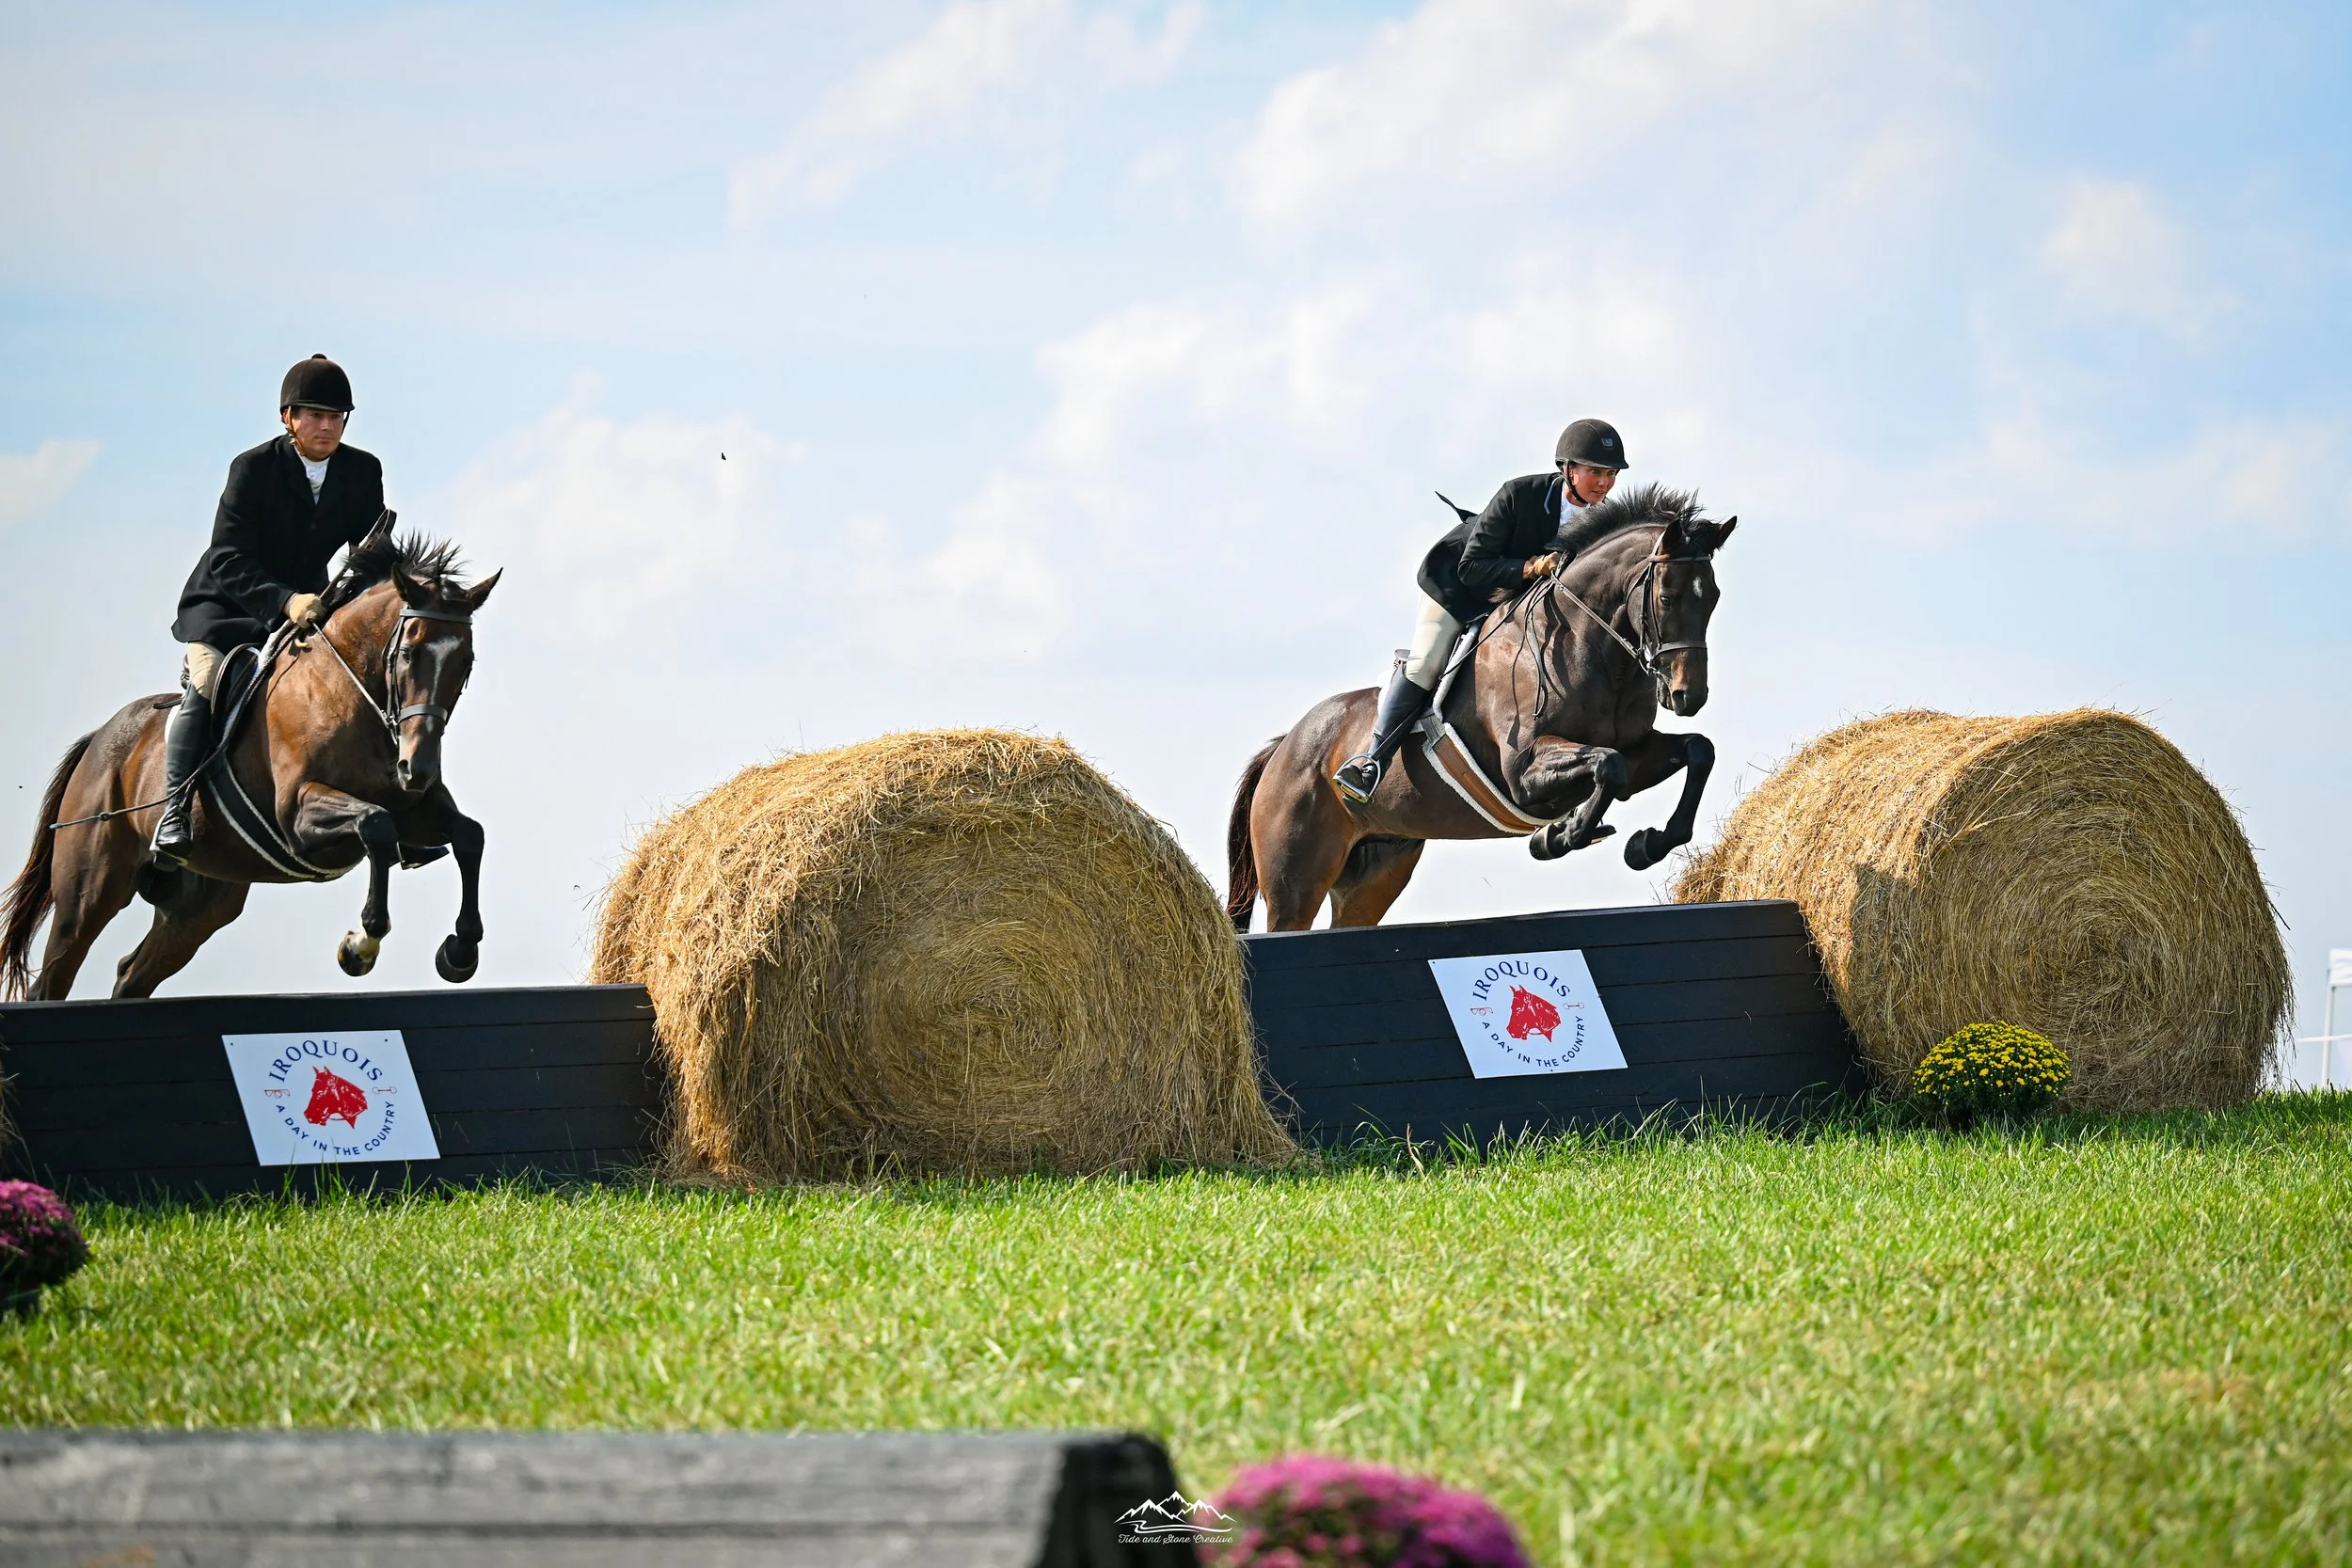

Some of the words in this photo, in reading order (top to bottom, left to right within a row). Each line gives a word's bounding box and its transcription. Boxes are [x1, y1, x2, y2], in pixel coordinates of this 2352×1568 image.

[1472, 959, 1570, 1001] IROQUOIS
[269, 1039, 383, 1083] IROQUOIS
[1490, 1033, 1513, 1053] DAY
[1518, 1053, 1531, 1064] IN
[1535, 1058, 1559, 1068] THE
[1561, 1016, 1585, 1063] COUNTRY
[276, 1104, 286, 1113] A
[284, 1117, 309, 1140] DAY
[313, 1139, 327, 1151] IN
[334, 1146, 360, 1156] THE
[364, 1101, 395, 1151] COUNTRY
